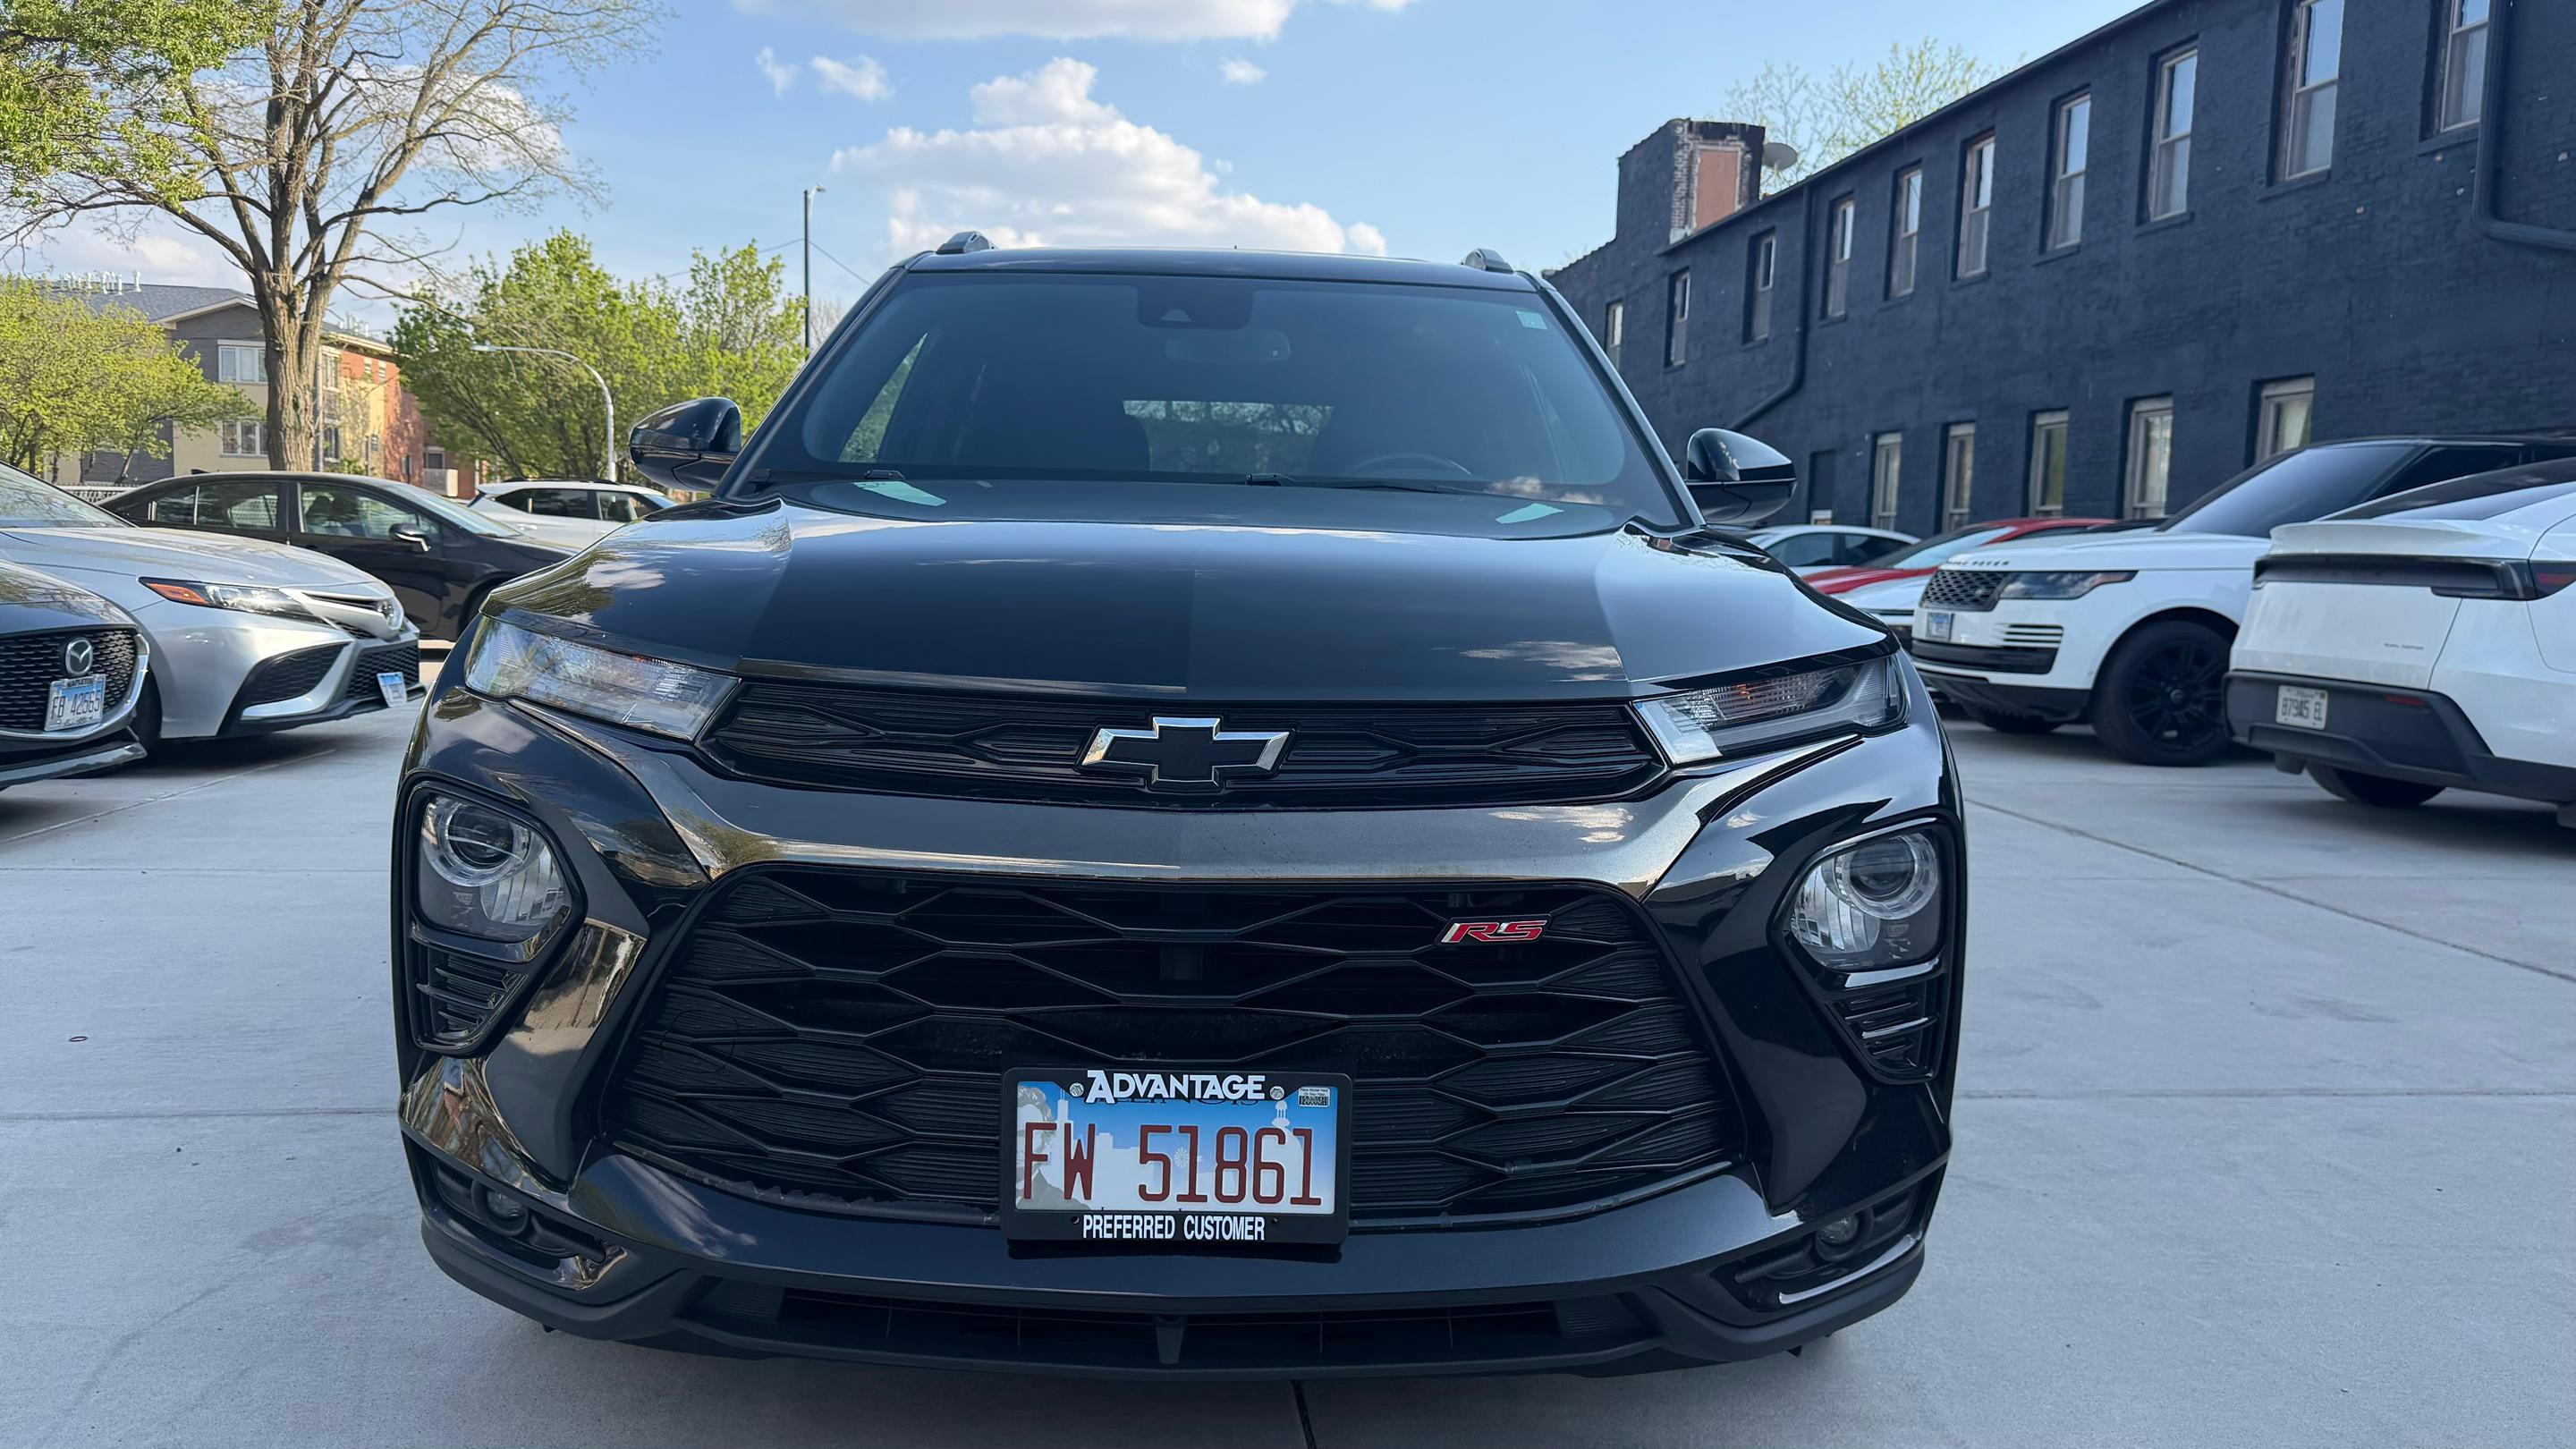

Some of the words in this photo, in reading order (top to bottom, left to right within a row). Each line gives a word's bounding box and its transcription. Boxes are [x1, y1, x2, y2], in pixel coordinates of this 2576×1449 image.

[1440, 919, 1547, 943] RS
[1086, 1070, 1266, 1104] ADVANTAGE
[1023, 1123, 1096, 1200] FW
[1138, 1124, 1322, 1205] 51861
[1082, 1214, 1175, 1240] PREFERRED
[1183, 1215, 1266, 1241] CUSTOMER
